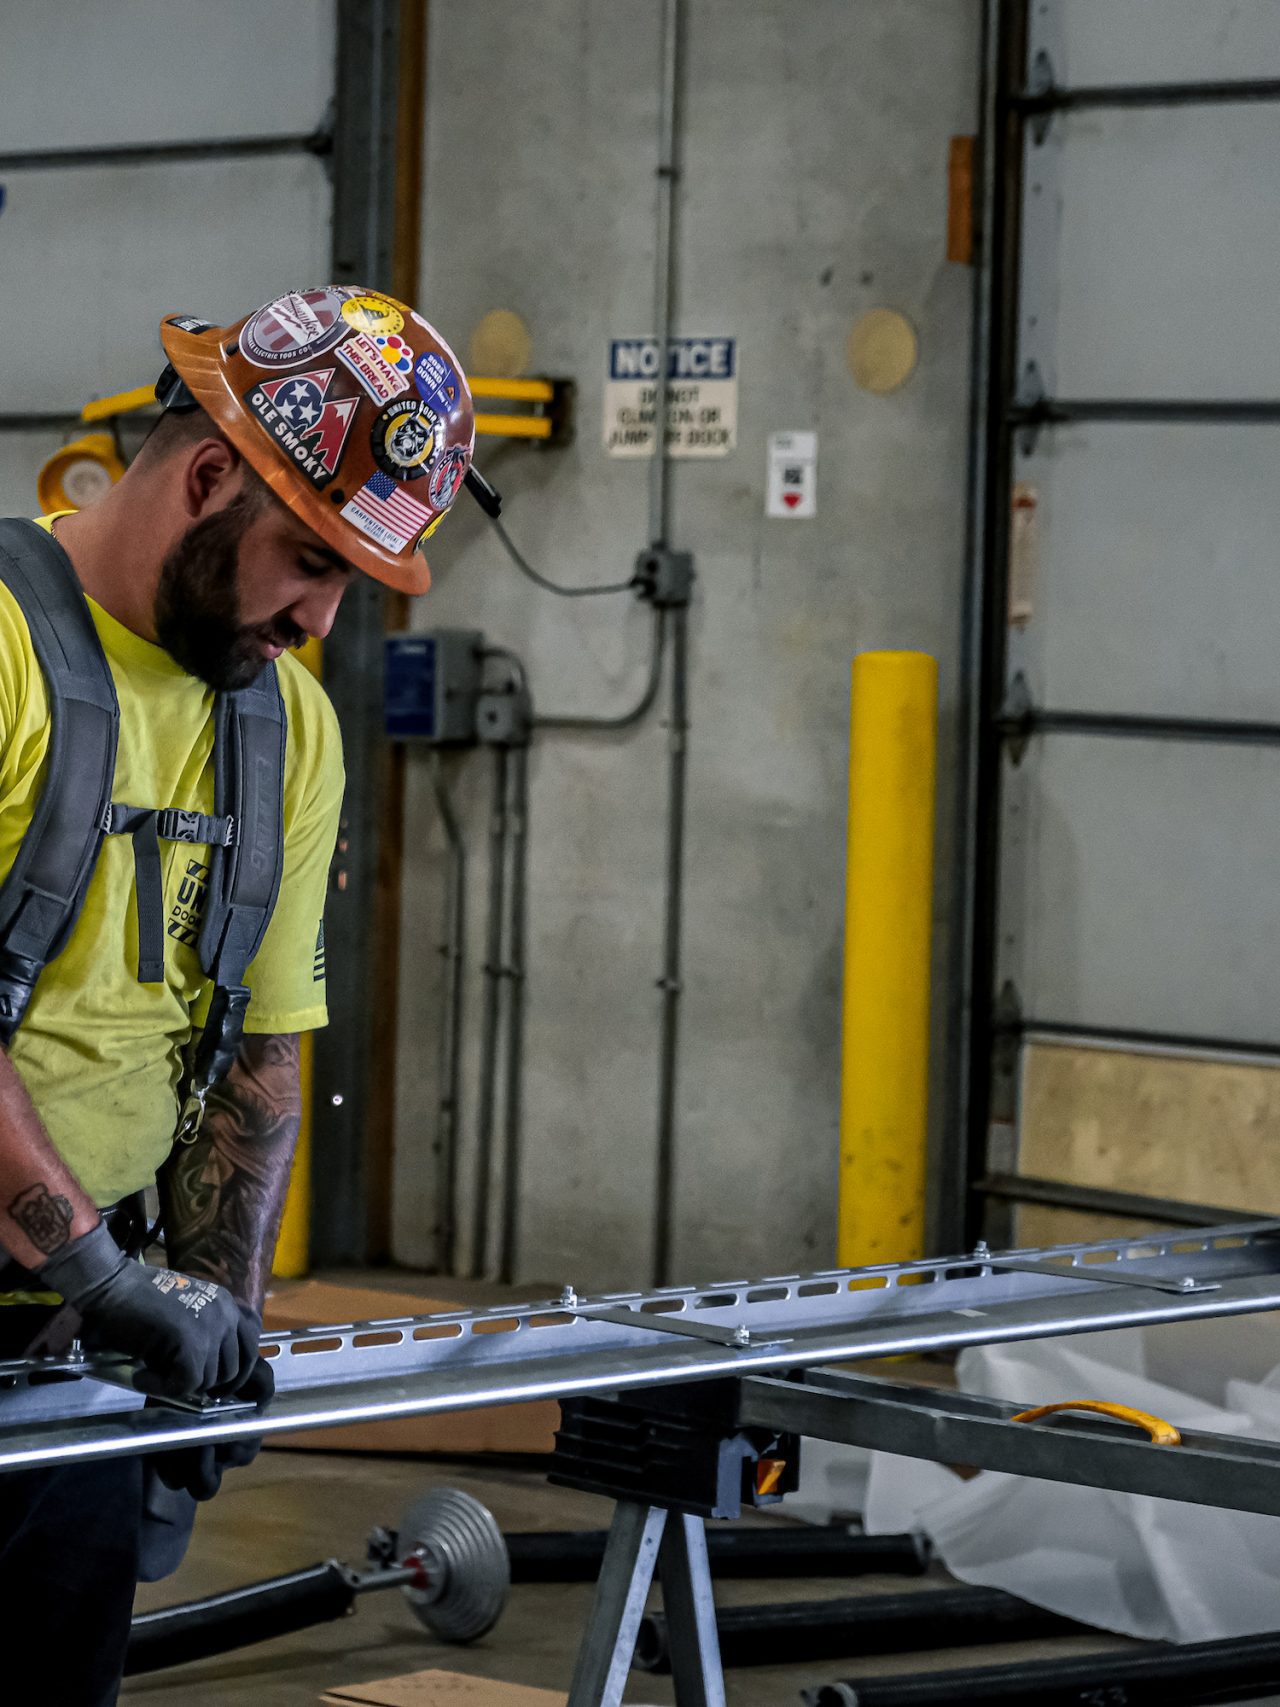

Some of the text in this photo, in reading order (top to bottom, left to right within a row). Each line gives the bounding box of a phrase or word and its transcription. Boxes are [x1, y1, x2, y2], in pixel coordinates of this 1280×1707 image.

[343, 343, 389, 398] THIS BREAD
[355, 337, 403, 392] LET'S MAKE
[416, 365, 438, 390] DOWN
[420, 358, 443, 383] STAND
[387, 400, 417, 417] UNITED
[251, 392, 328, 480] OLE SMOKY
